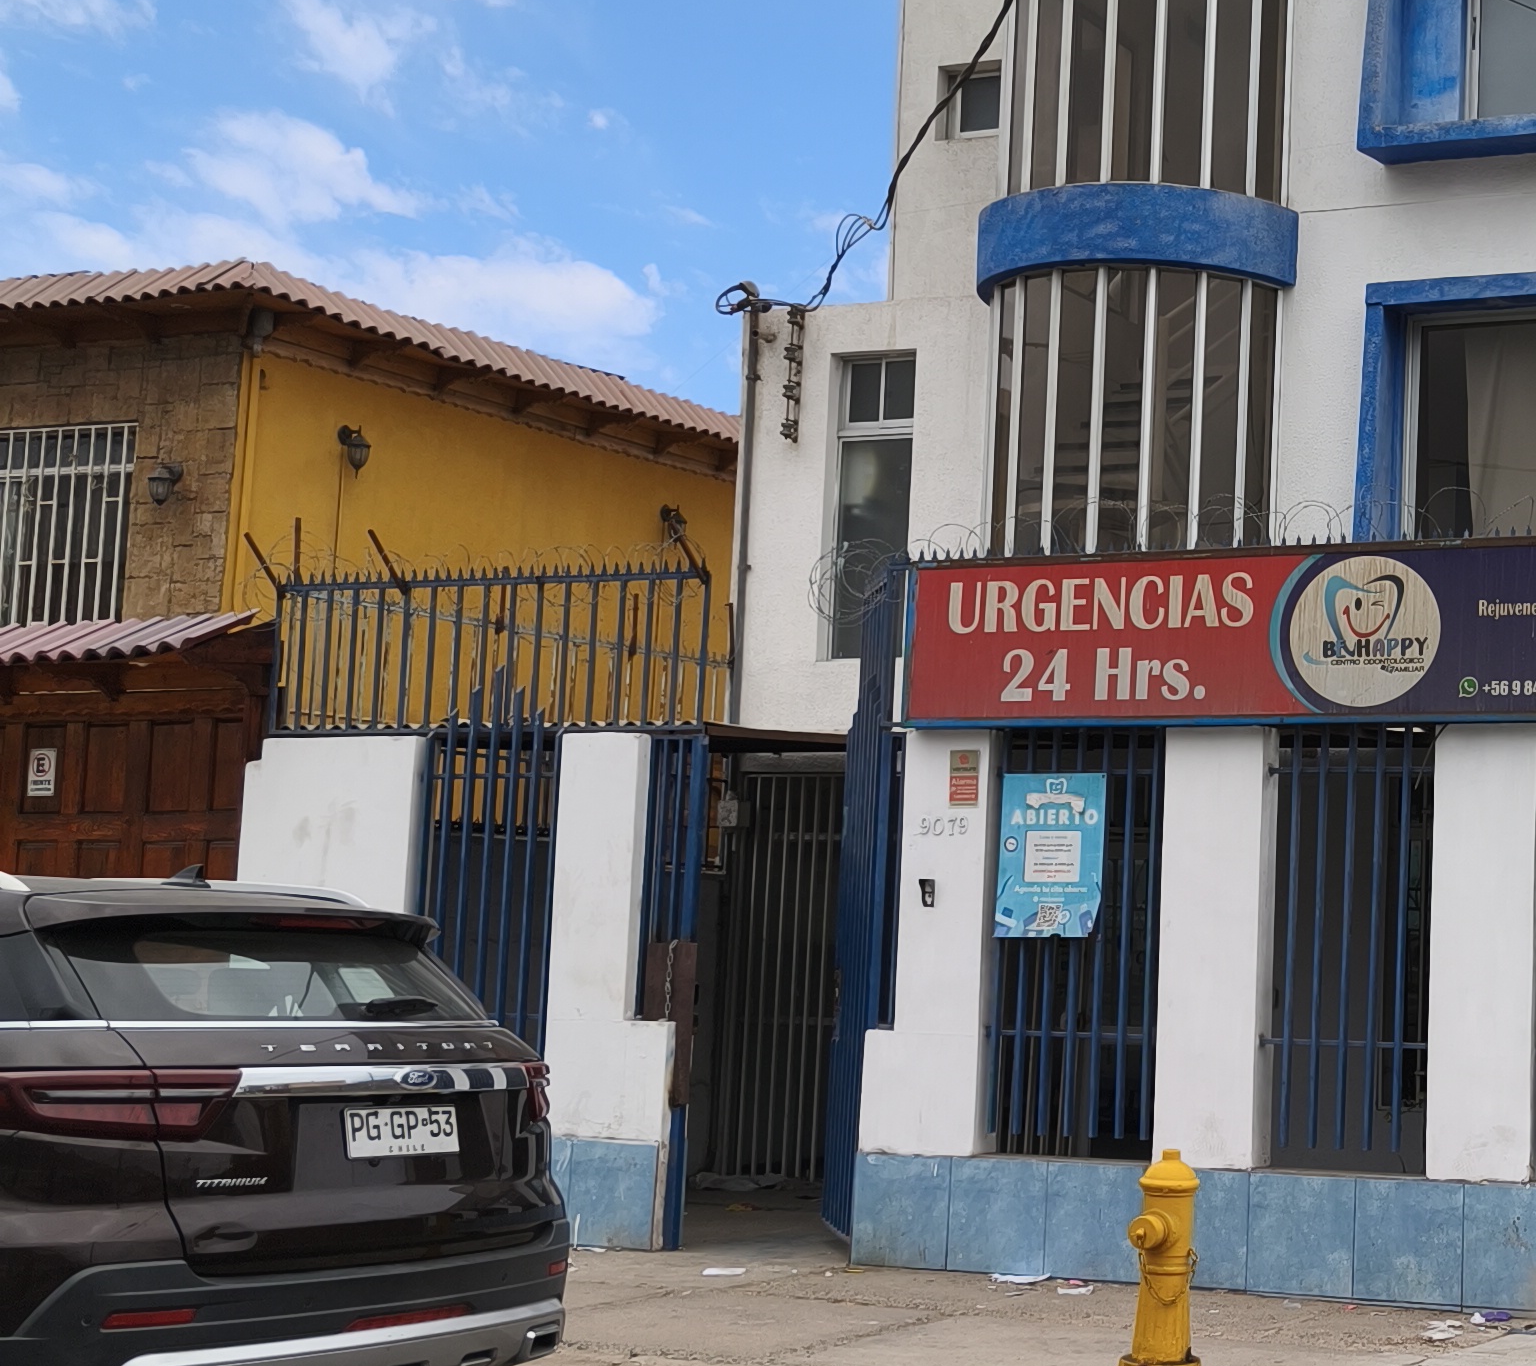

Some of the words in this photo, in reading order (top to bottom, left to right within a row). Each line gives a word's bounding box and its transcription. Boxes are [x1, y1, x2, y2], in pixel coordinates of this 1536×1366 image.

[948, 571, 1254, 634] URGENCIAS
[1356, 637, 1428, 658] HAPPY
[1001, 648, 1072, 702] 24
[1094, 646, 1206, 702] Hrs.
[1482, 680, 1509, 696] +56
[1512, 680, 1522, 696] 9
[918, 815, 969, 836] 9079
[1011, 809, 1098, 825] ABIERTO
[408, 1071, 429, 1084] Ford
